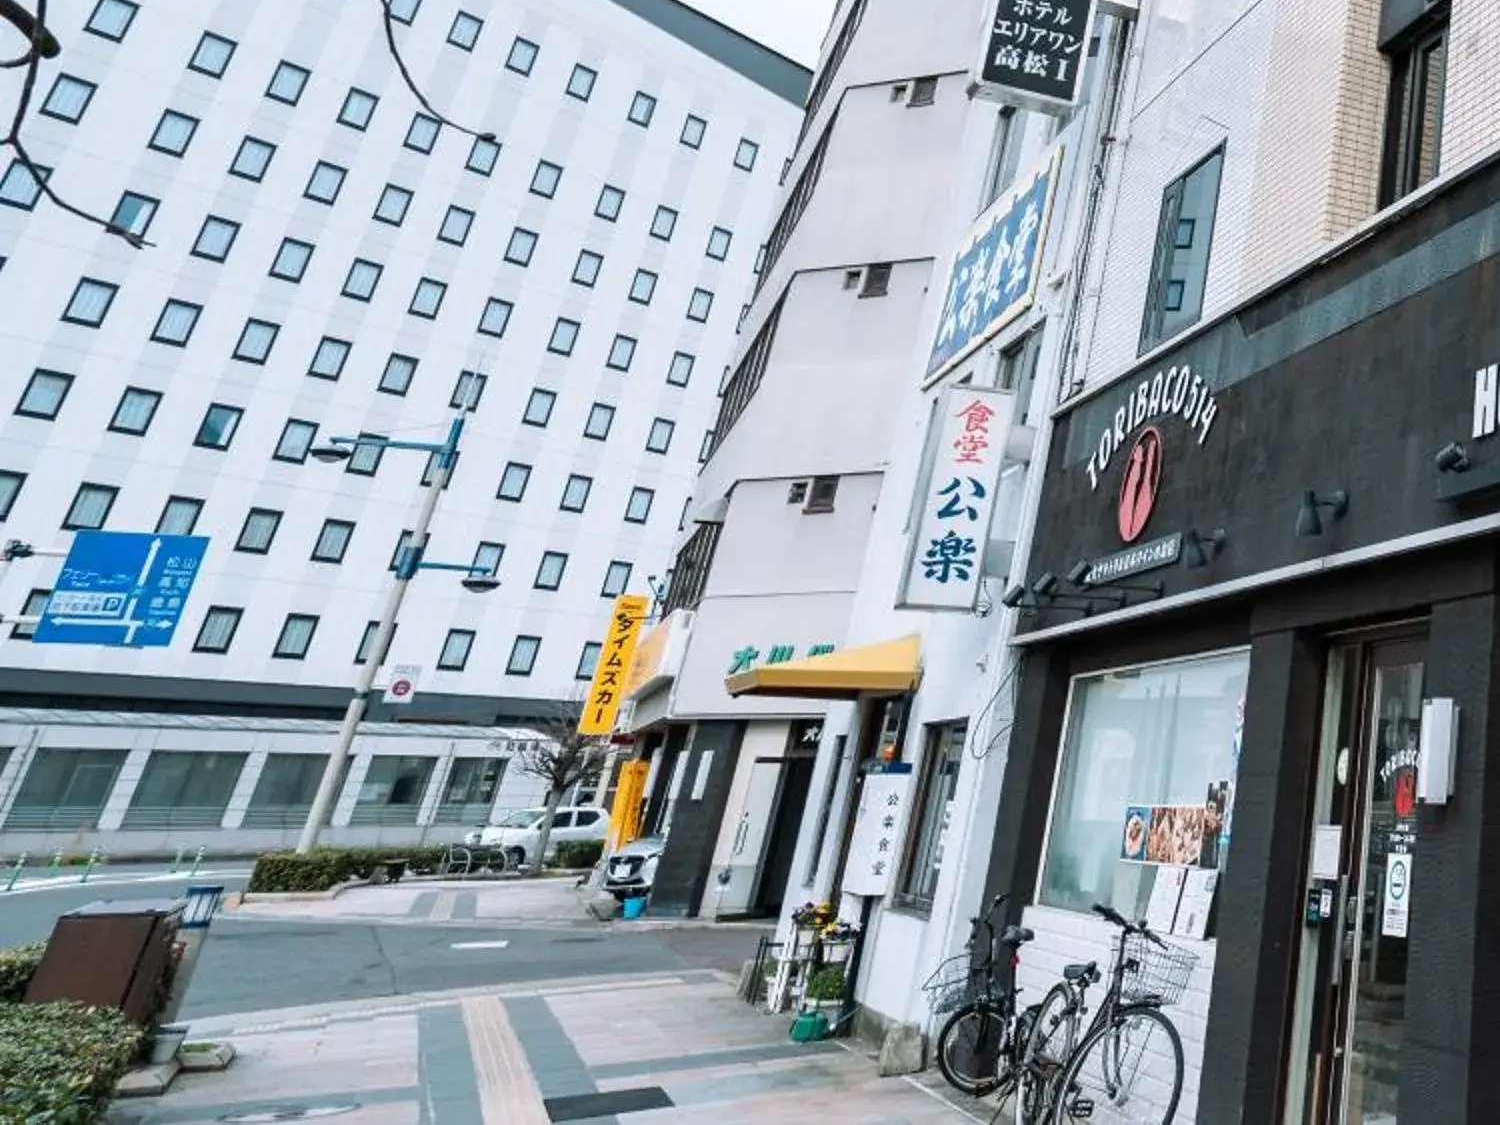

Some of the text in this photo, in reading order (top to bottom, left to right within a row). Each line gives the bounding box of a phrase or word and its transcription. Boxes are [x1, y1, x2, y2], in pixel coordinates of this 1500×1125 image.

[993, 17, 1081, 55] エリアワン
[1085, 364, 1219, 491] TORIBACO514
[921, 398, 996, 584] 食堂 公楽
[594, 613, 634, 723] タイムズカー
[872, 792, 899, 876] 公楽食堂
